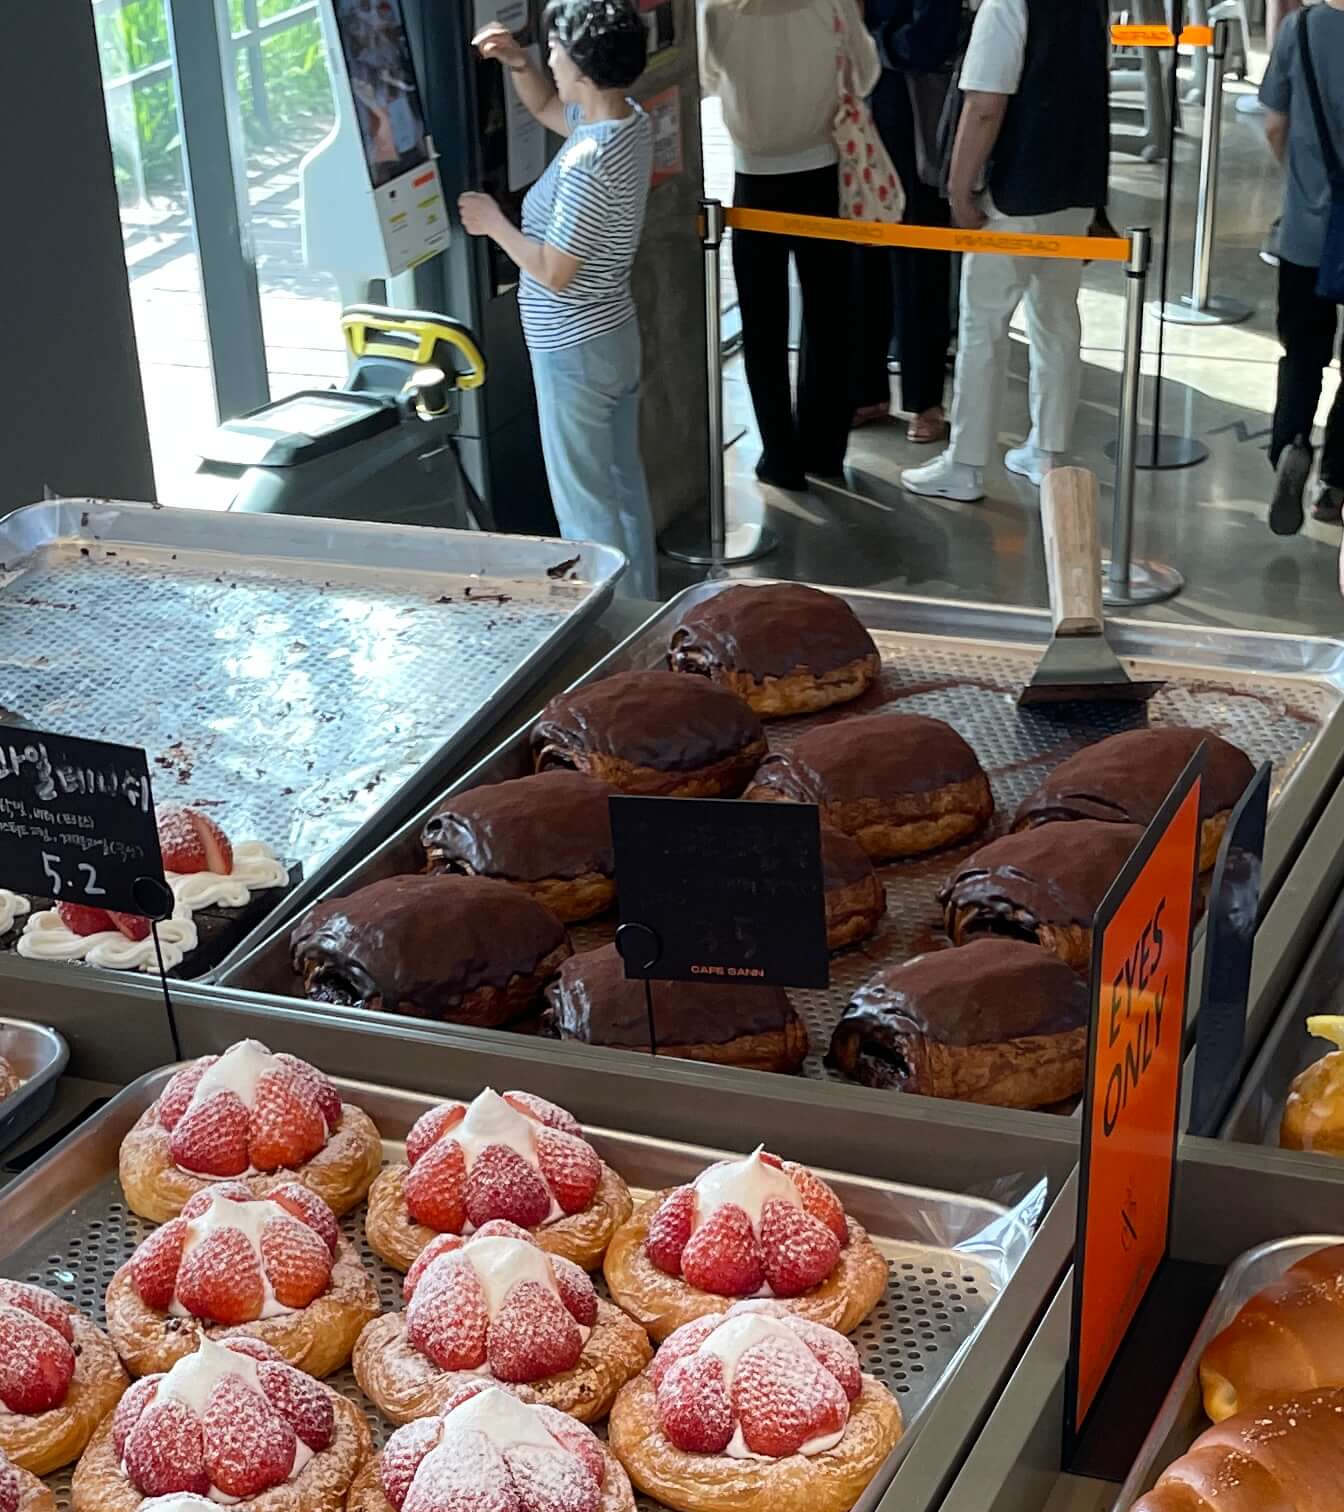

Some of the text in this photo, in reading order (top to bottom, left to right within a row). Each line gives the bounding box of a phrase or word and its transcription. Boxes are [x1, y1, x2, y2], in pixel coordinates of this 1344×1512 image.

[41, 851, 107, 895] 5.2
[690, 965, 724, 976] CAFE
[1109, 896, 1167, 1048] EYES
[1103, 975, 1169, 1138] ONLY
